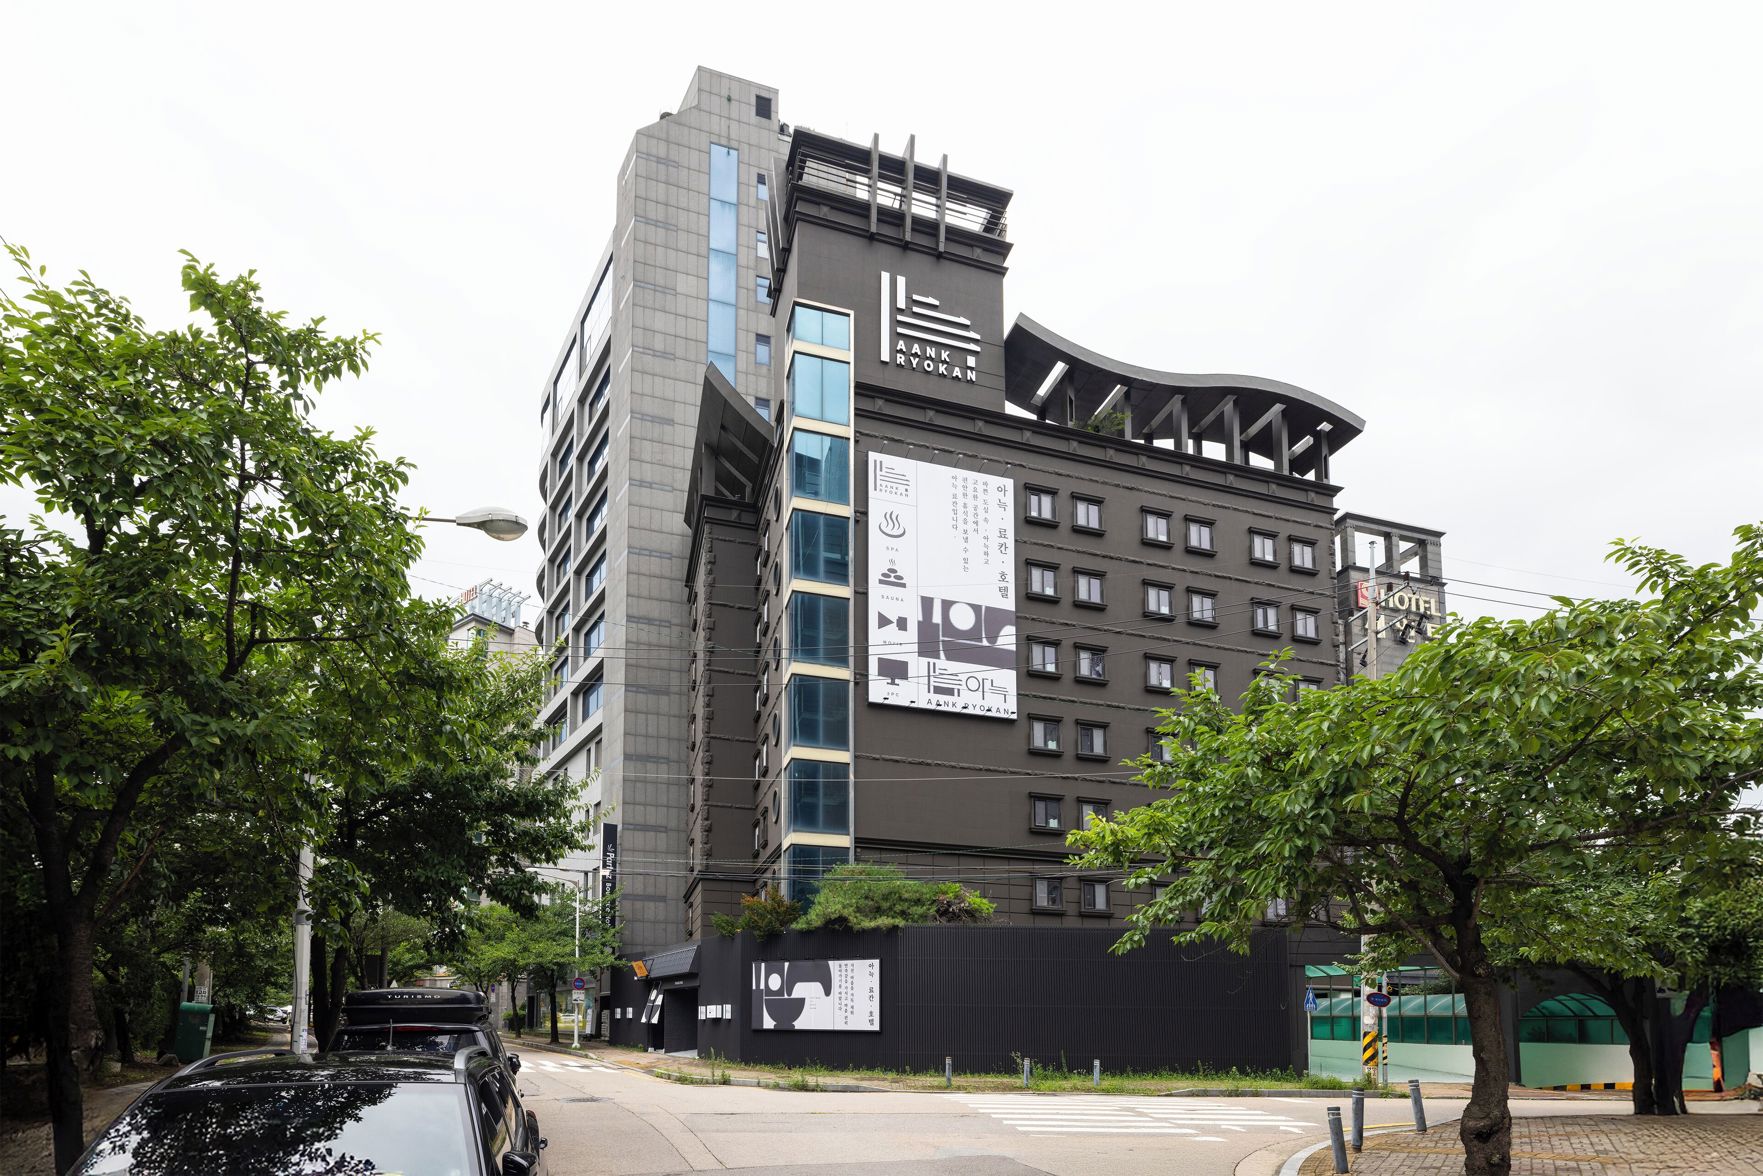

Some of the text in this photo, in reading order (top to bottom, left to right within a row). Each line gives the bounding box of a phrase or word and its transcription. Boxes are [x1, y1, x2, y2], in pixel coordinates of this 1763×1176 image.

[896, 340, 950, 362] AANK
[896, 353, 976, 382] RYOKAN
[997, 484, 1009, 599] 아늑 료칸 호텔
[881, 594, 904, 602] SAUNA
[1380, 588, 1441, 617] HOTEL
[927, 698, 957, 708] AANK
[964, 703, 1009, 715] RYOKAN
[606, 852, 614, 879] Partz
